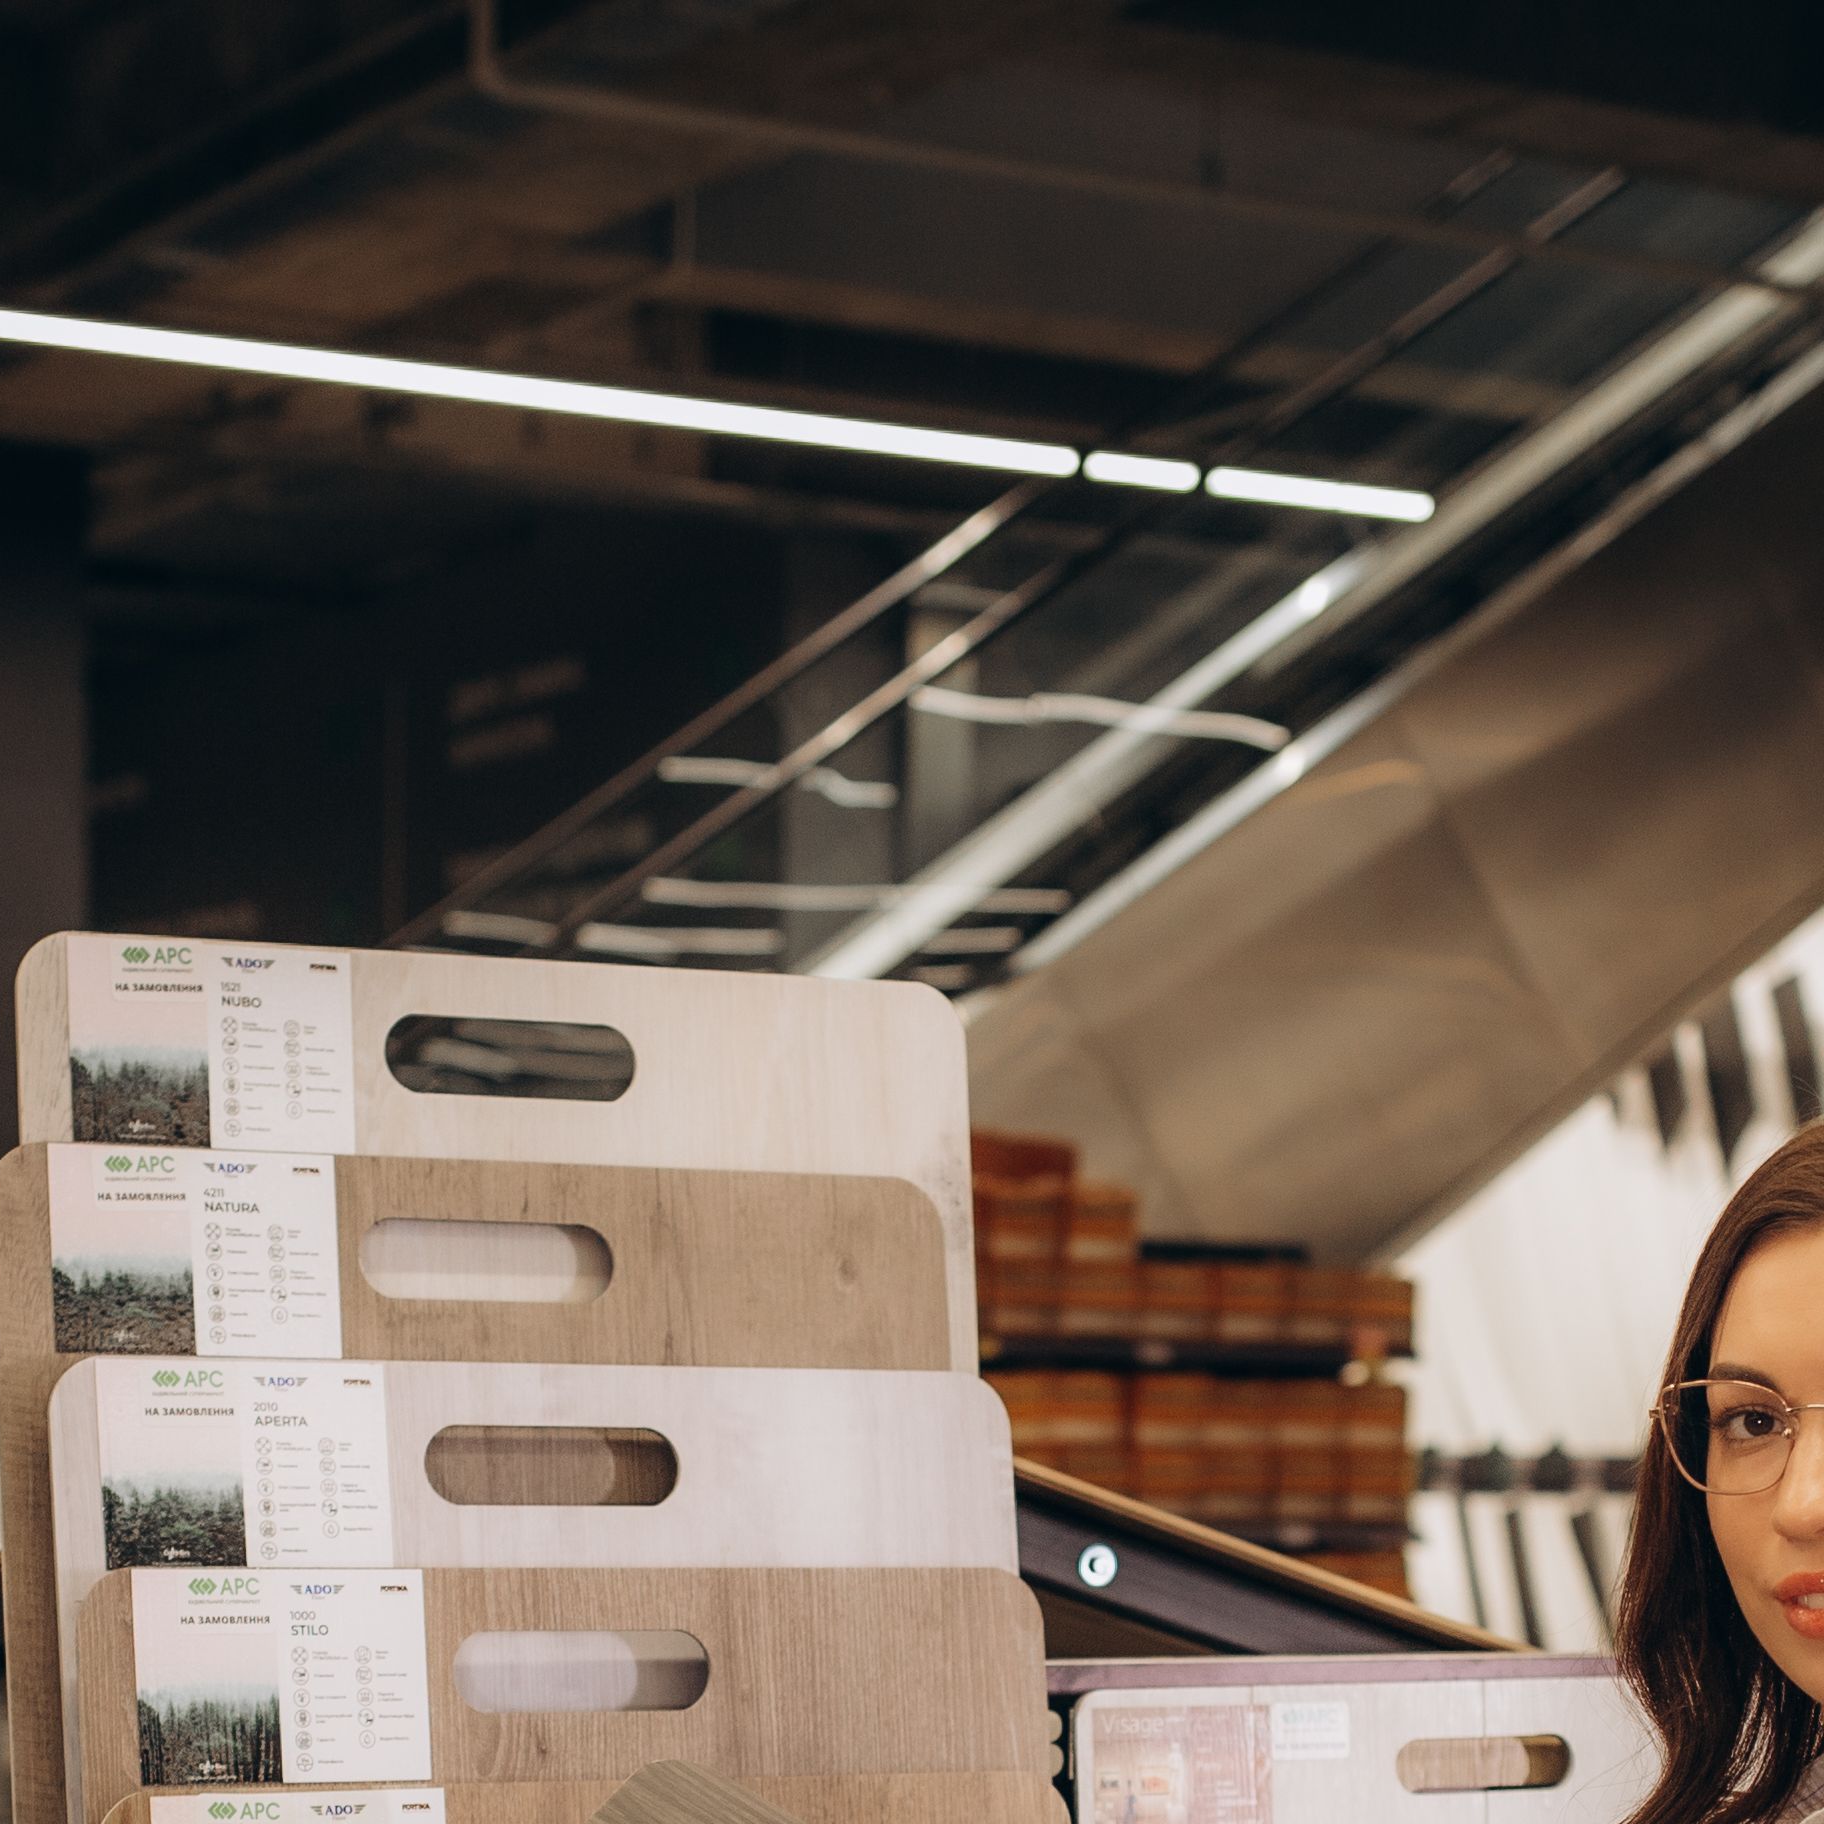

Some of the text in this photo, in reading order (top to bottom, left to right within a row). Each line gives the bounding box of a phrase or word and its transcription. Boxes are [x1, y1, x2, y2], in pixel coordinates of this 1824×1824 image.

[236, 959, 263, 968] ADO
[221, 996, 261, 1008] NUBO
[218, 1164, 245, 1173] ADO
[205, 1203, 259, 1213] NATURA
[268, 1377, 295, 1386] ADO
[163, 1408, 234, 1416] ЗАМОВЛЕННЯ
[255, 1416, 308, 1427] APERTA
[305, 1585, 332, 1594] ADO
[198, 1616, 270, 1624] ЗАМОВЛЕННЯ
[290, 1611, 315, 1620] 1000
[291, 1625, 328, 1636] STILO
[1101, 1715, 1165, 1739] Visage
[326, 1805, 353, 1815] ADO
